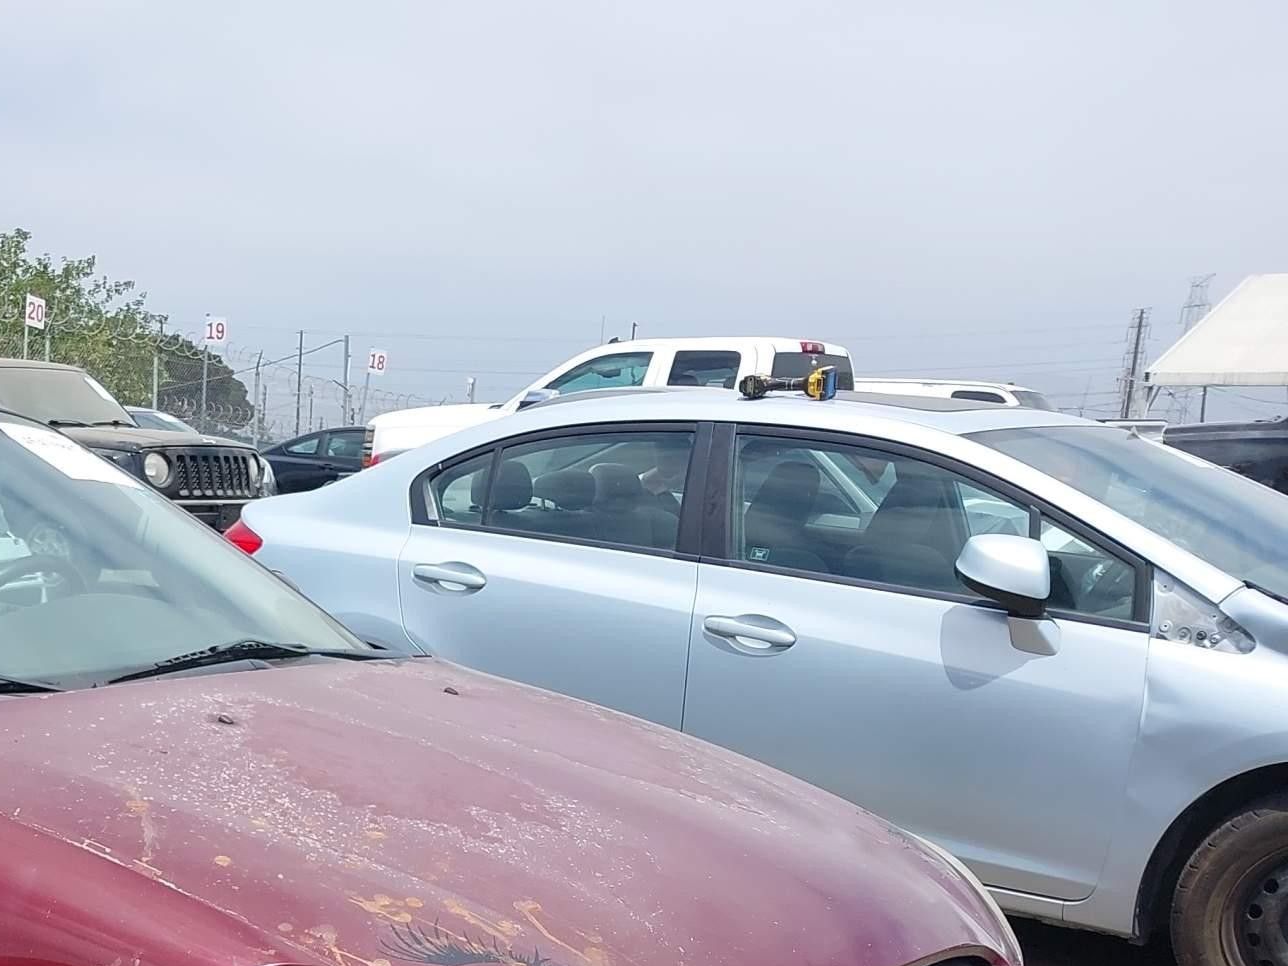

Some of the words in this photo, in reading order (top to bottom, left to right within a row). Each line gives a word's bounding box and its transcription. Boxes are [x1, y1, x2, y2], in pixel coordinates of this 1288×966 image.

[28, 301, 44, 322] 20
[206, 321, 225, 340] 19
[369, 353, 386, 371] 18
